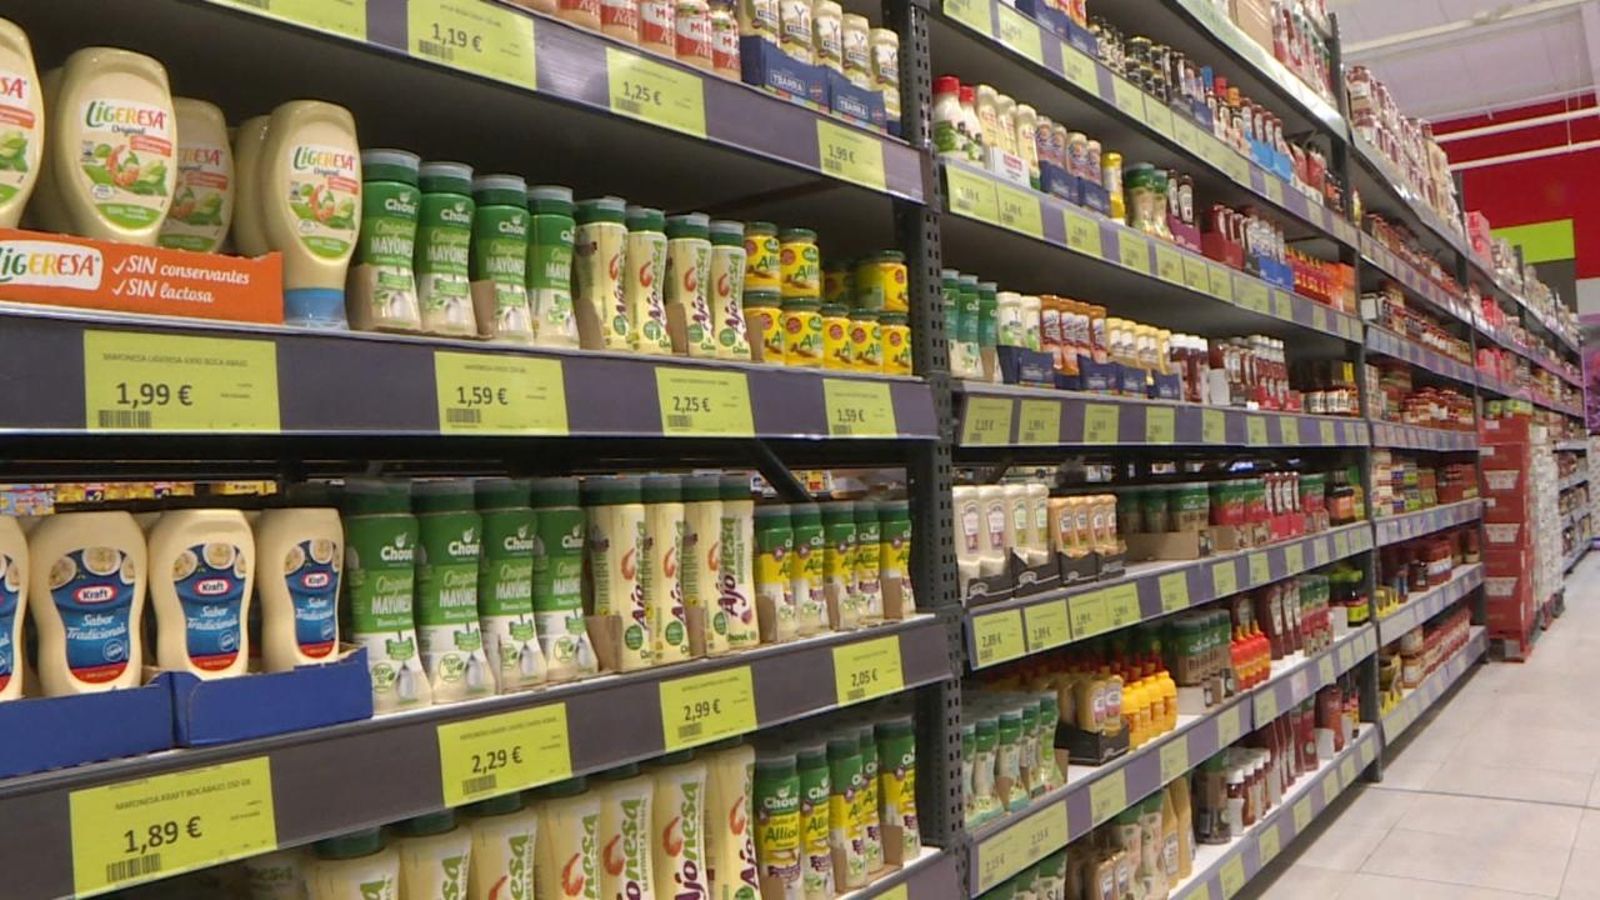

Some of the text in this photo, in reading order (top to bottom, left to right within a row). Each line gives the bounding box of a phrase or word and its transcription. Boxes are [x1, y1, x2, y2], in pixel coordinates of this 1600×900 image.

[432, 23, 482, 53] 1,19 €
[623, 81, 662, 106] 1,25 €
[128, 255, 250, 285] SIN conservantes
[127, 279, 214, 303] SIN lactosa
[116, 382, 170, 409] 1,99
[177, 384, 193, 406] €
[457, 386, 508, 407] 1,59 €
[673, 396, 711, 413] 2,25 €
[837, 409, 865, 422] 1,59 €
[716, 517, 747, 617] Ajonesa
[83, 588, 108, 599] Kraft
[202, 583, 224, 592] Kraft
[82, 614, 114, 626] Sabor
[202, 605, 228, 617] Sabor
[67, 622, 126, 640] Tradicional
[188, 614, 238, 630] Tradicional
[851, 668, 879, 687] 2,05 €
[684, 699, 721, 722] 2,99 €
[472, 746, 523, 774] 2,29 €
[124, 816, 202, 854] 1,89 €
